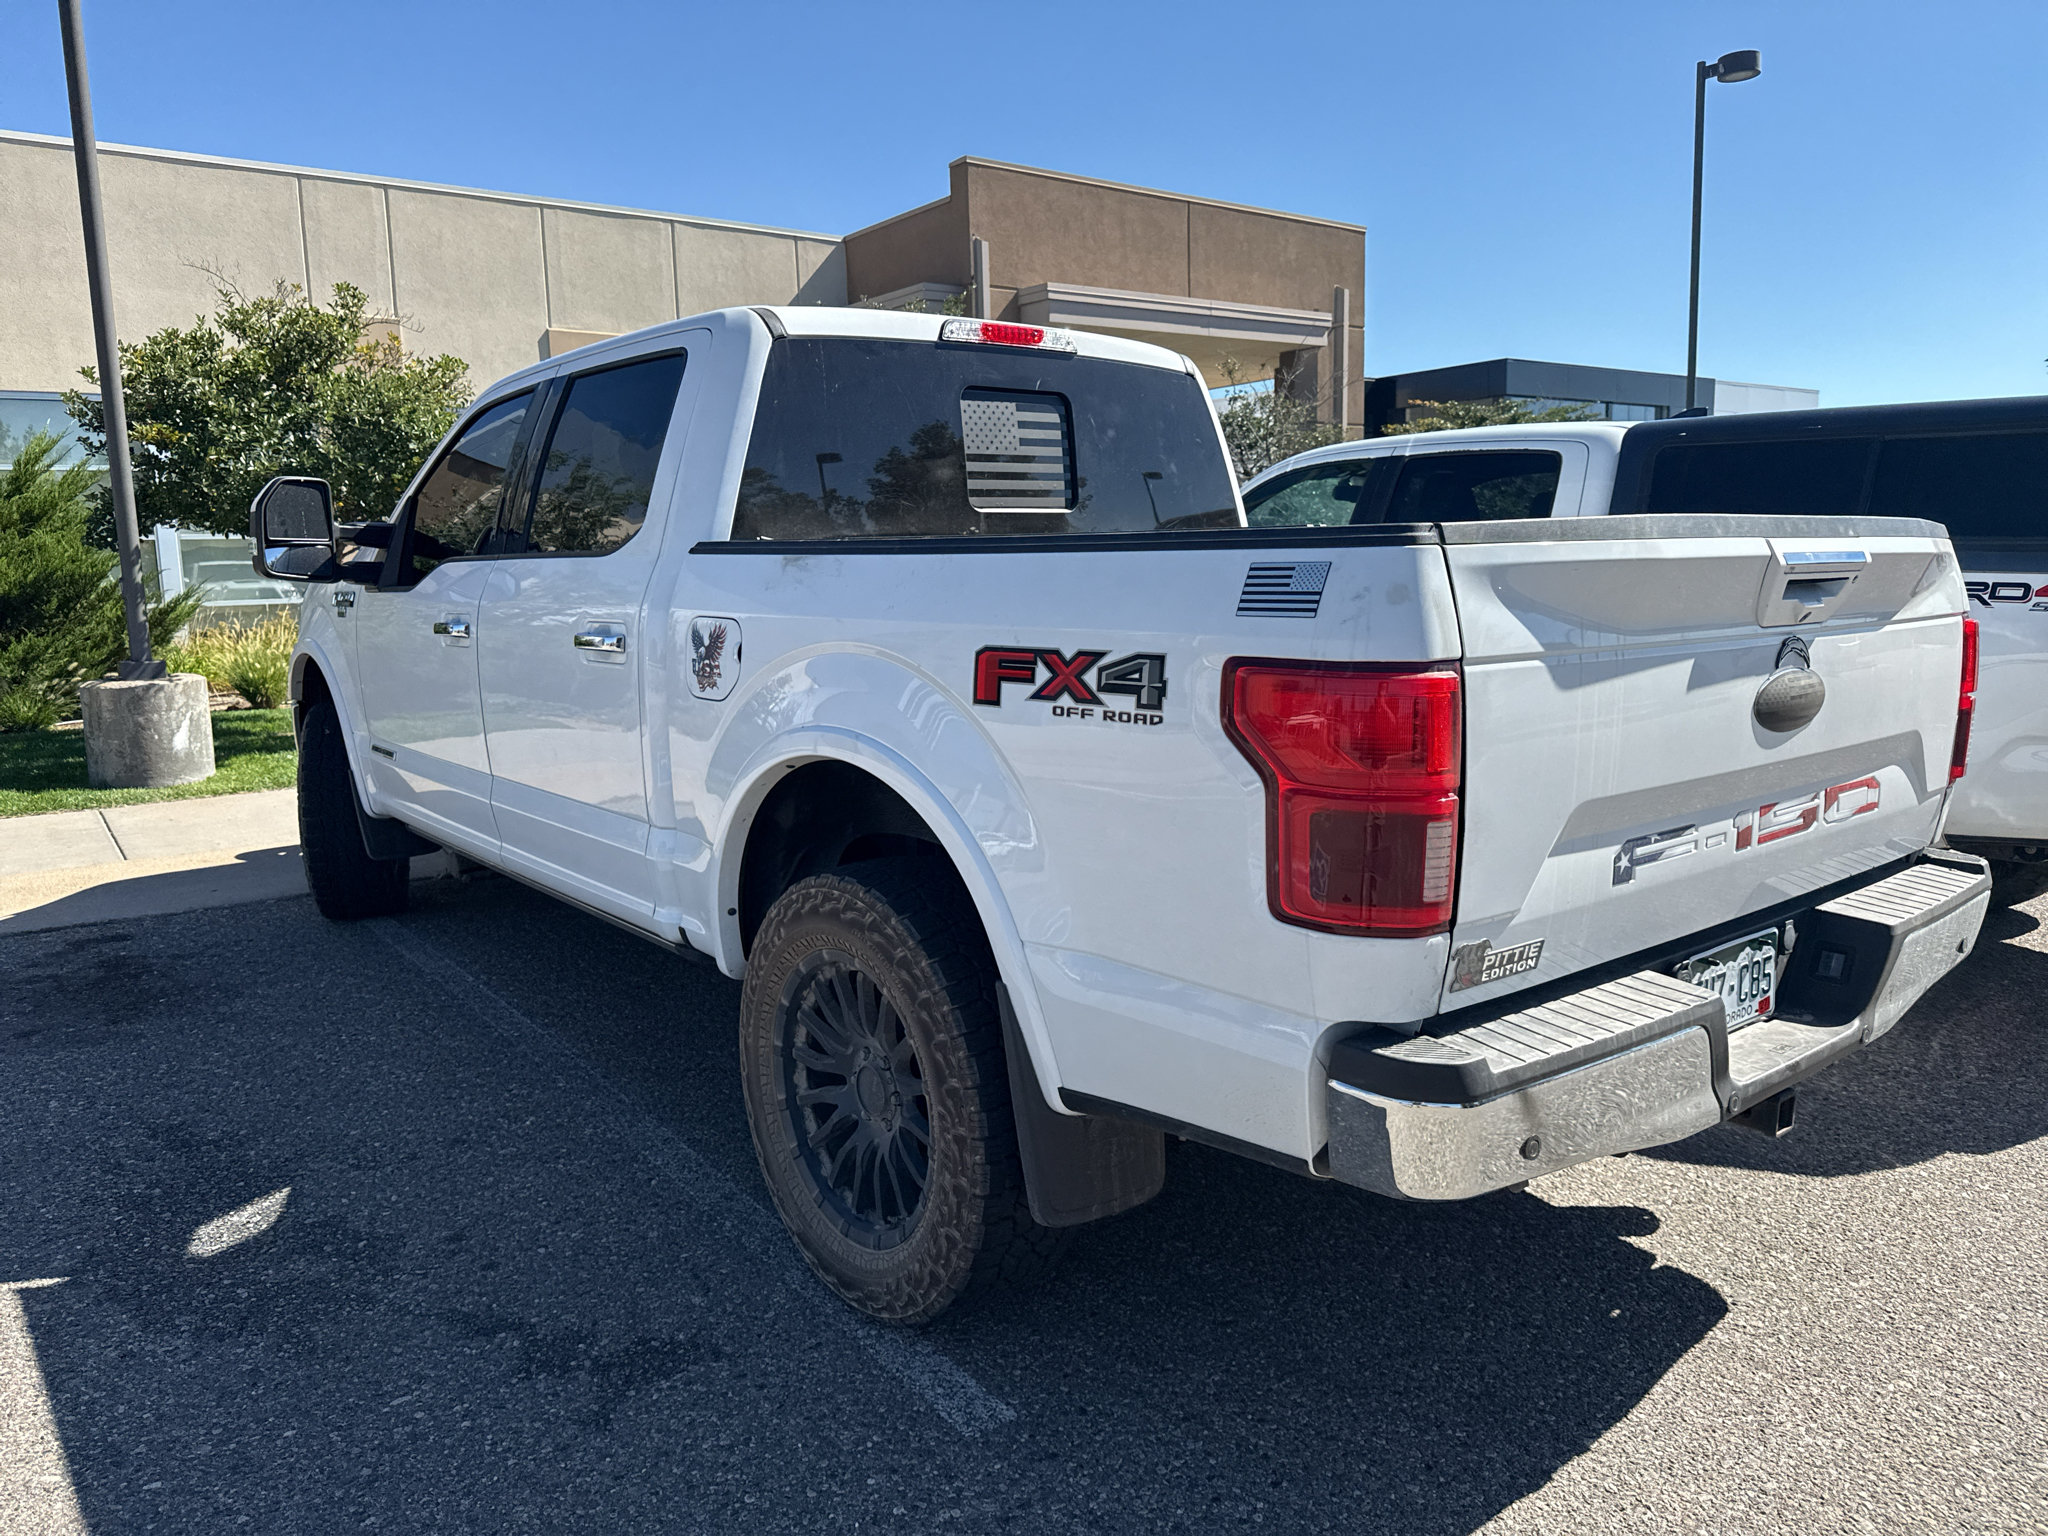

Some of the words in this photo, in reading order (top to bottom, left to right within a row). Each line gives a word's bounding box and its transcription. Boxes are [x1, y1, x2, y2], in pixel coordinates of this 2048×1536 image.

[1964, 581, 2034, 608] RD
[973, 645, 1168, 711] FX4
[1052, 705, 1094, 719] OFF
[1102, 709, 1164, 726] ROAD
[1612, 776, 1881, 887] F-150
[1481, 957, 1537, 982] EDITION
[1482, 942, 1541, 970] PITTIE
[1726, 1004, 1753, 1025] ORADO
